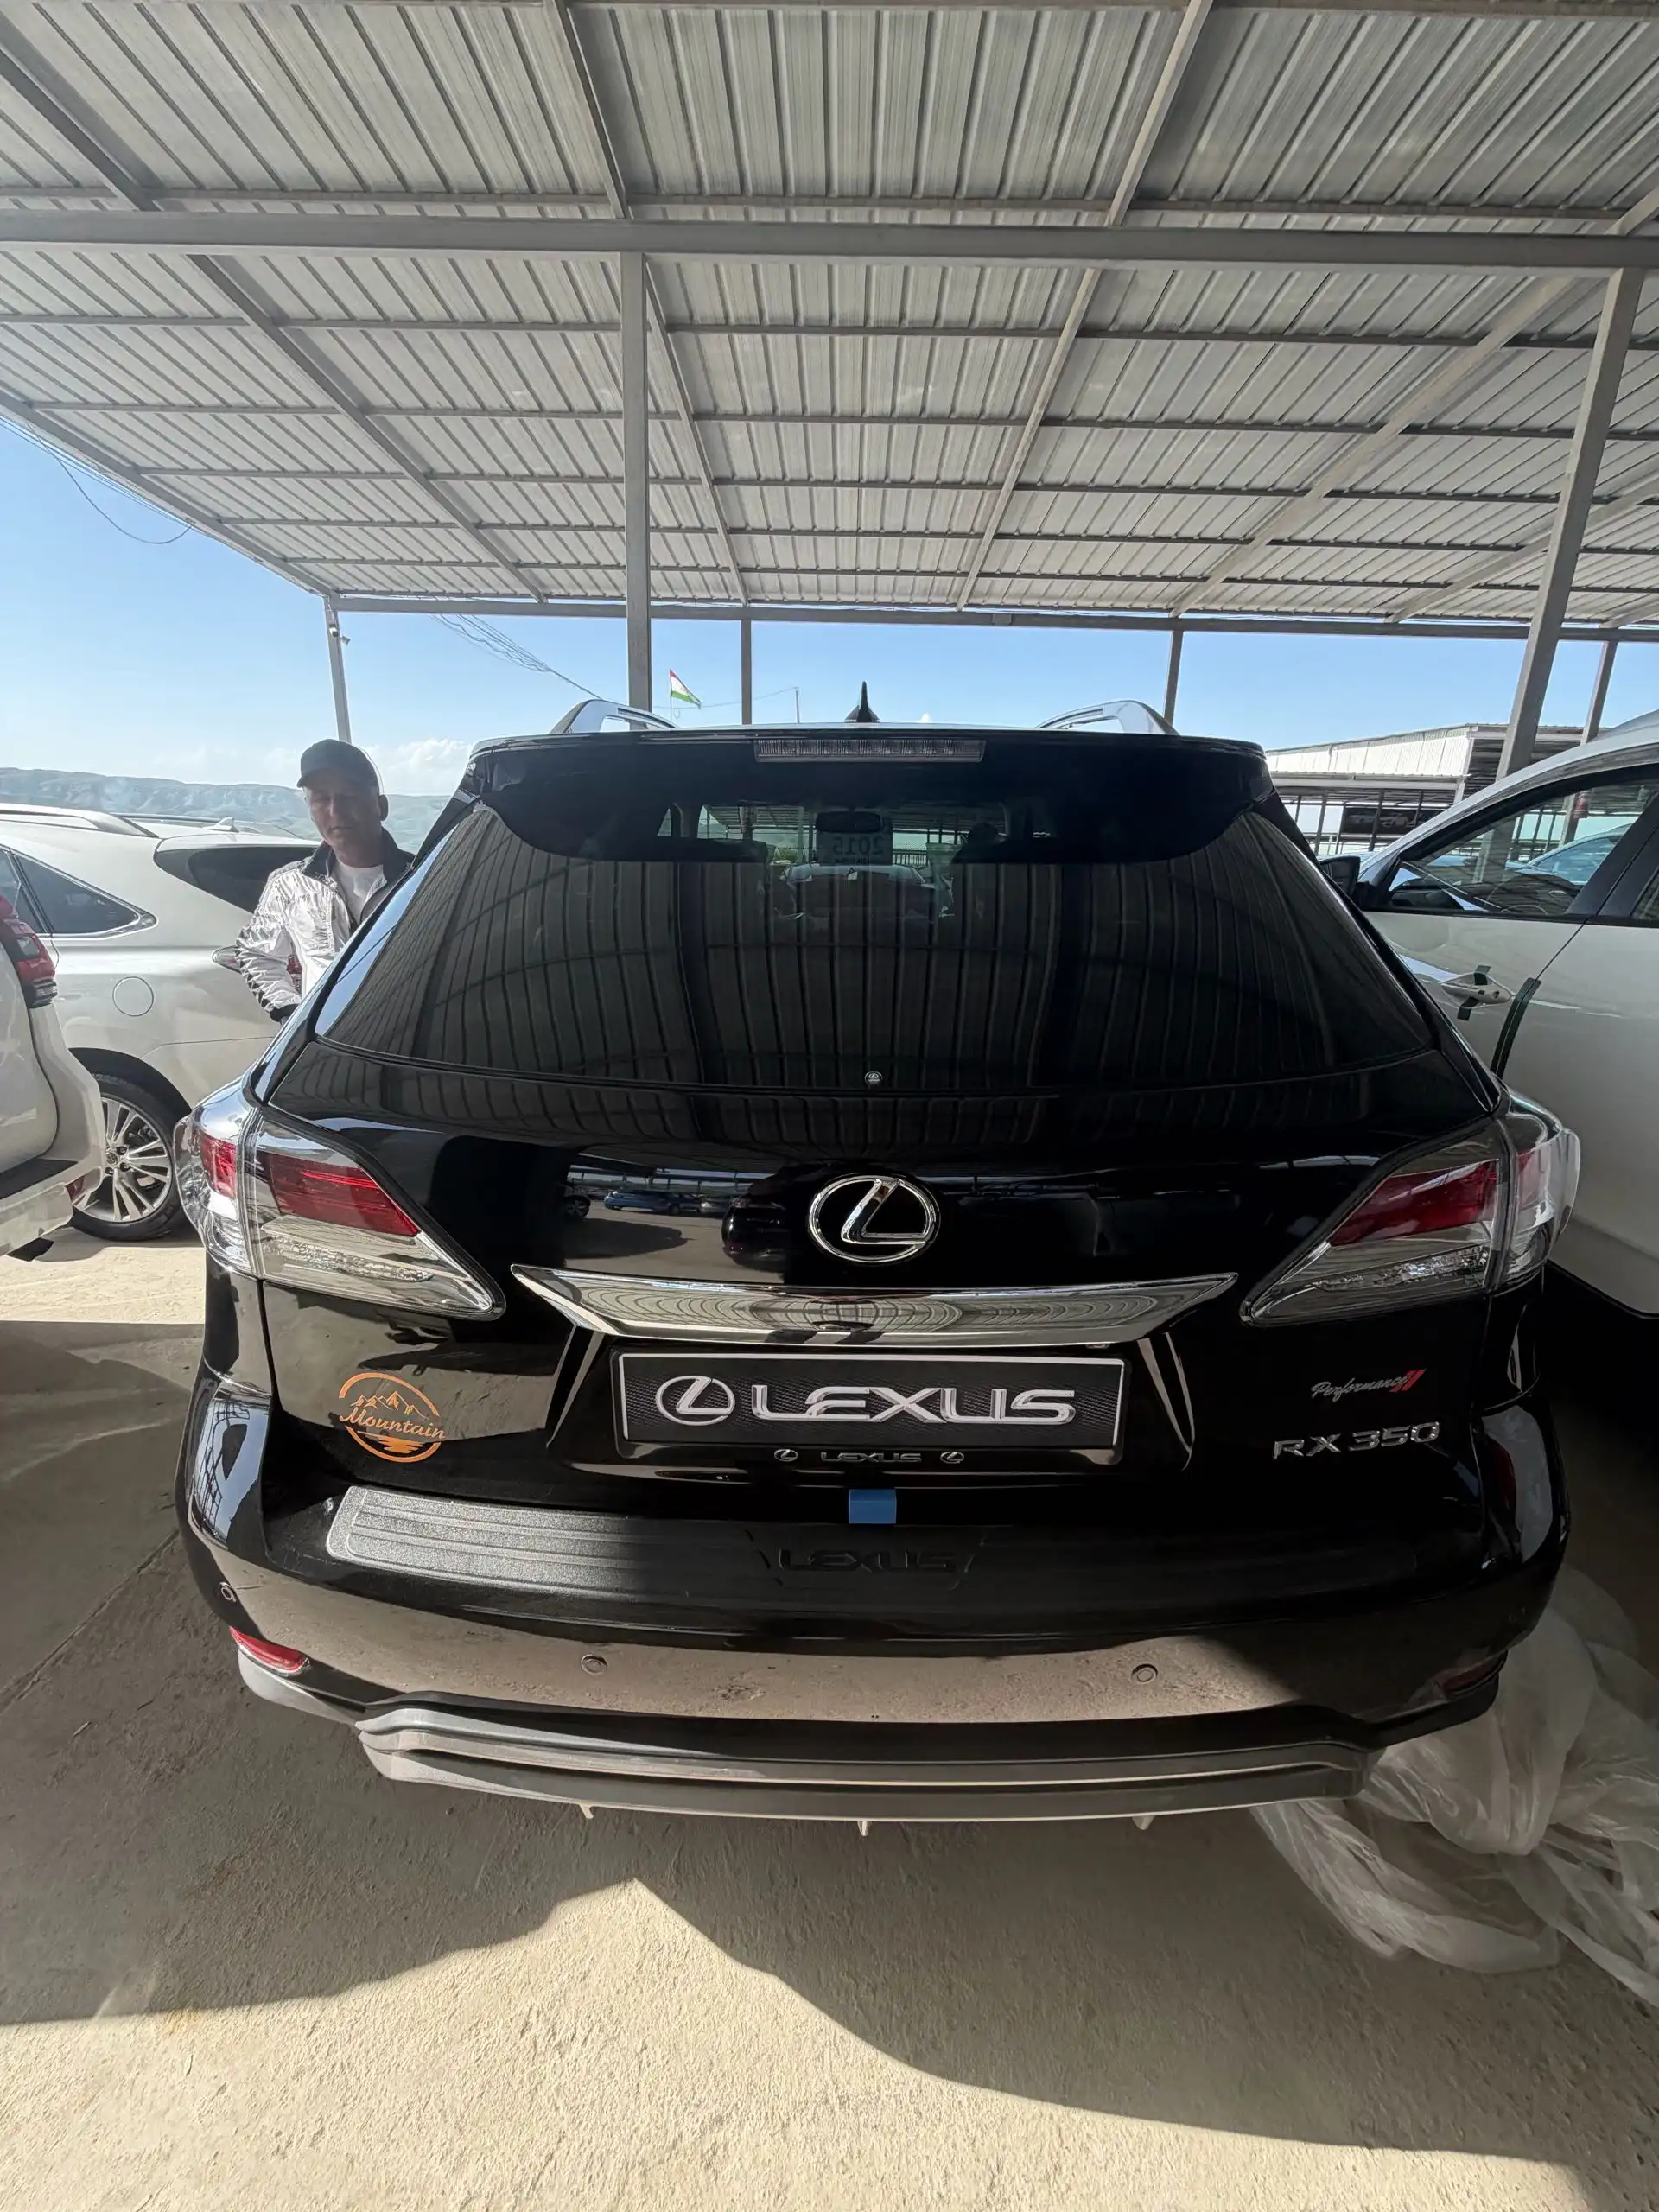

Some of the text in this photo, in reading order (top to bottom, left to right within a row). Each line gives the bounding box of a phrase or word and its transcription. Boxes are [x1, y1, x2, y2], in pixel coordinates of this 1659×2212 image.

[1311, 1375, 1410, 1402] Performance
[751, 1384, 1077, 1424] LEXUS
[339, 1407, 446, 1440] Mountain
[1272, 1421, 1440, 1460] RX 350
[820, 1451, 922, 1463] LEXUS
[779, 1548, 957, 1573] LEXUS
